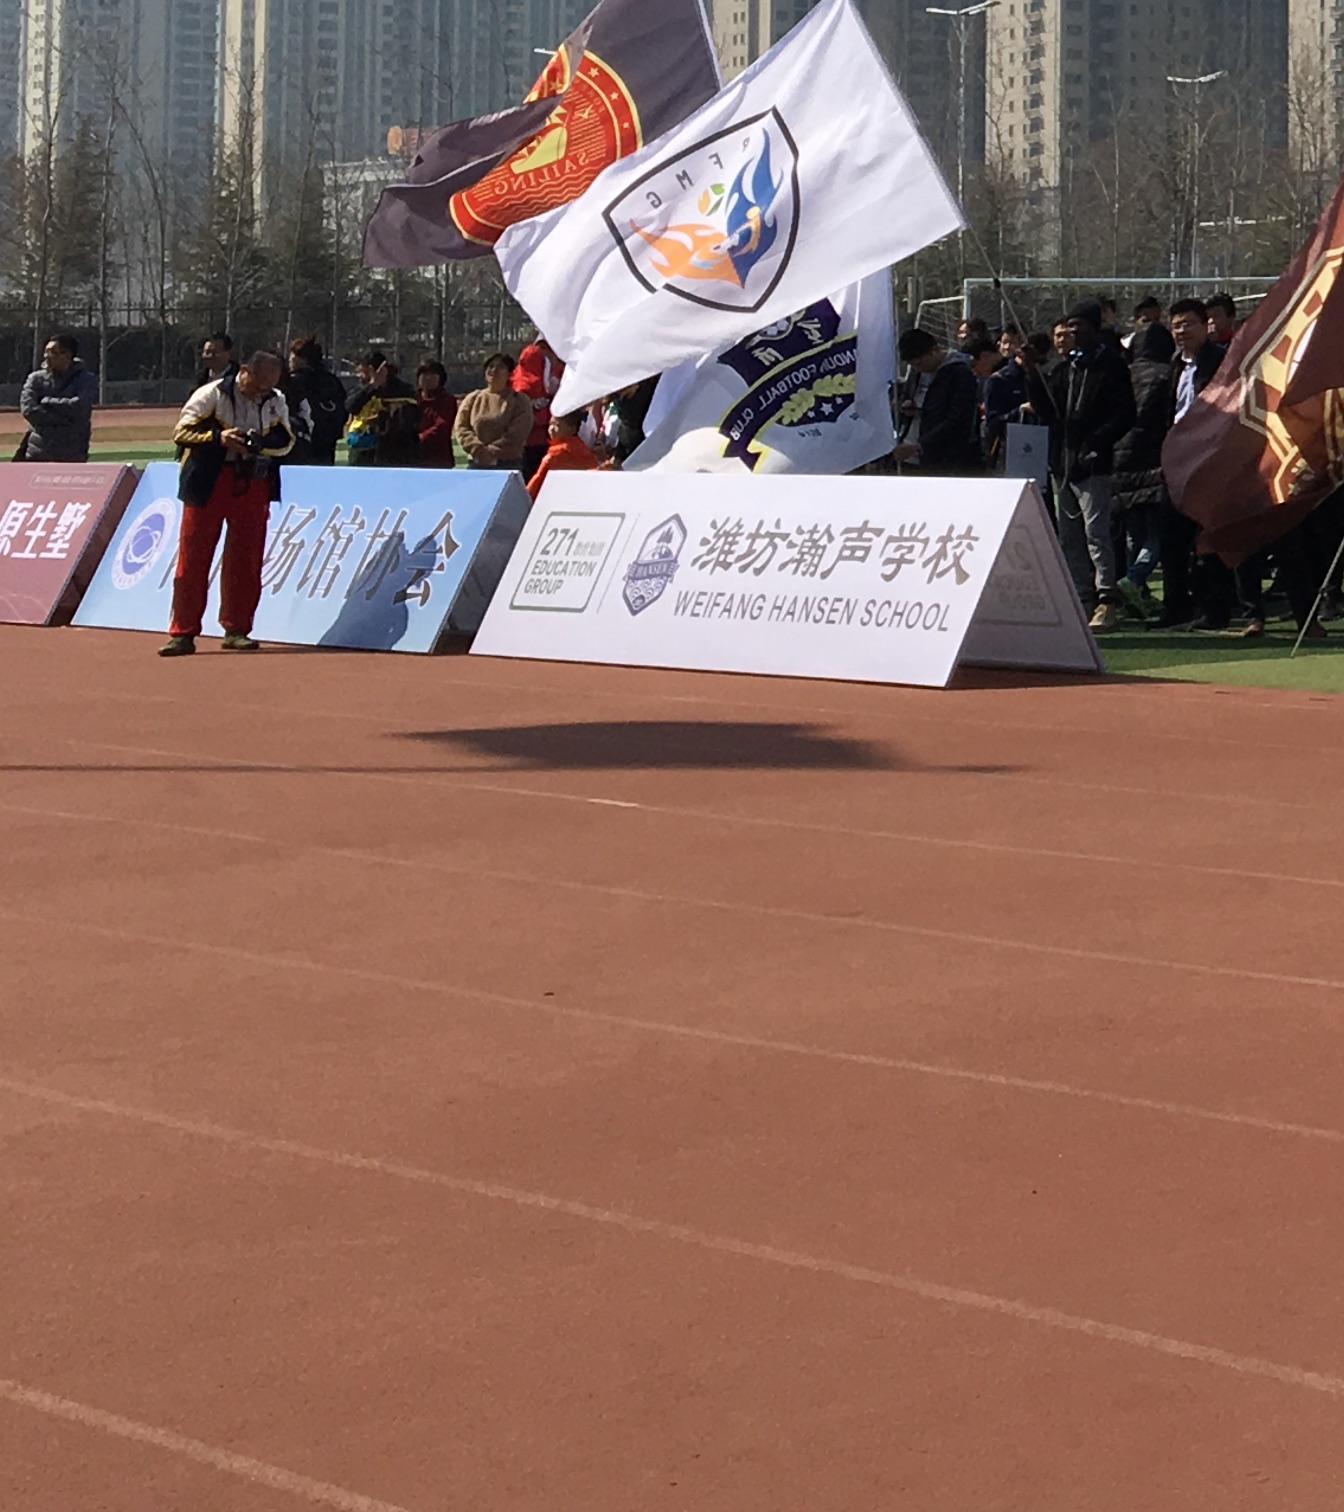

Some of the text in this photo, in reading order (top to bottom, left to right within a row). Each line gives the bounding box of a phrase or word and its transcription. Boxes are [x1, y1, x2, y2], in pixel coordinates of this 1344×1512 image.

[158, 504, 461, 607] 场馆协会
[540, 528, 579, 556] 271
[691, 516, 982, 587] 潍坊瀚声学校
[524, 578, 564, 594] GROUP
[531, 560, 598, 577] EDUCATION
[674, 590, 951, 633] WEIFANG HANSEN SCHOOL
